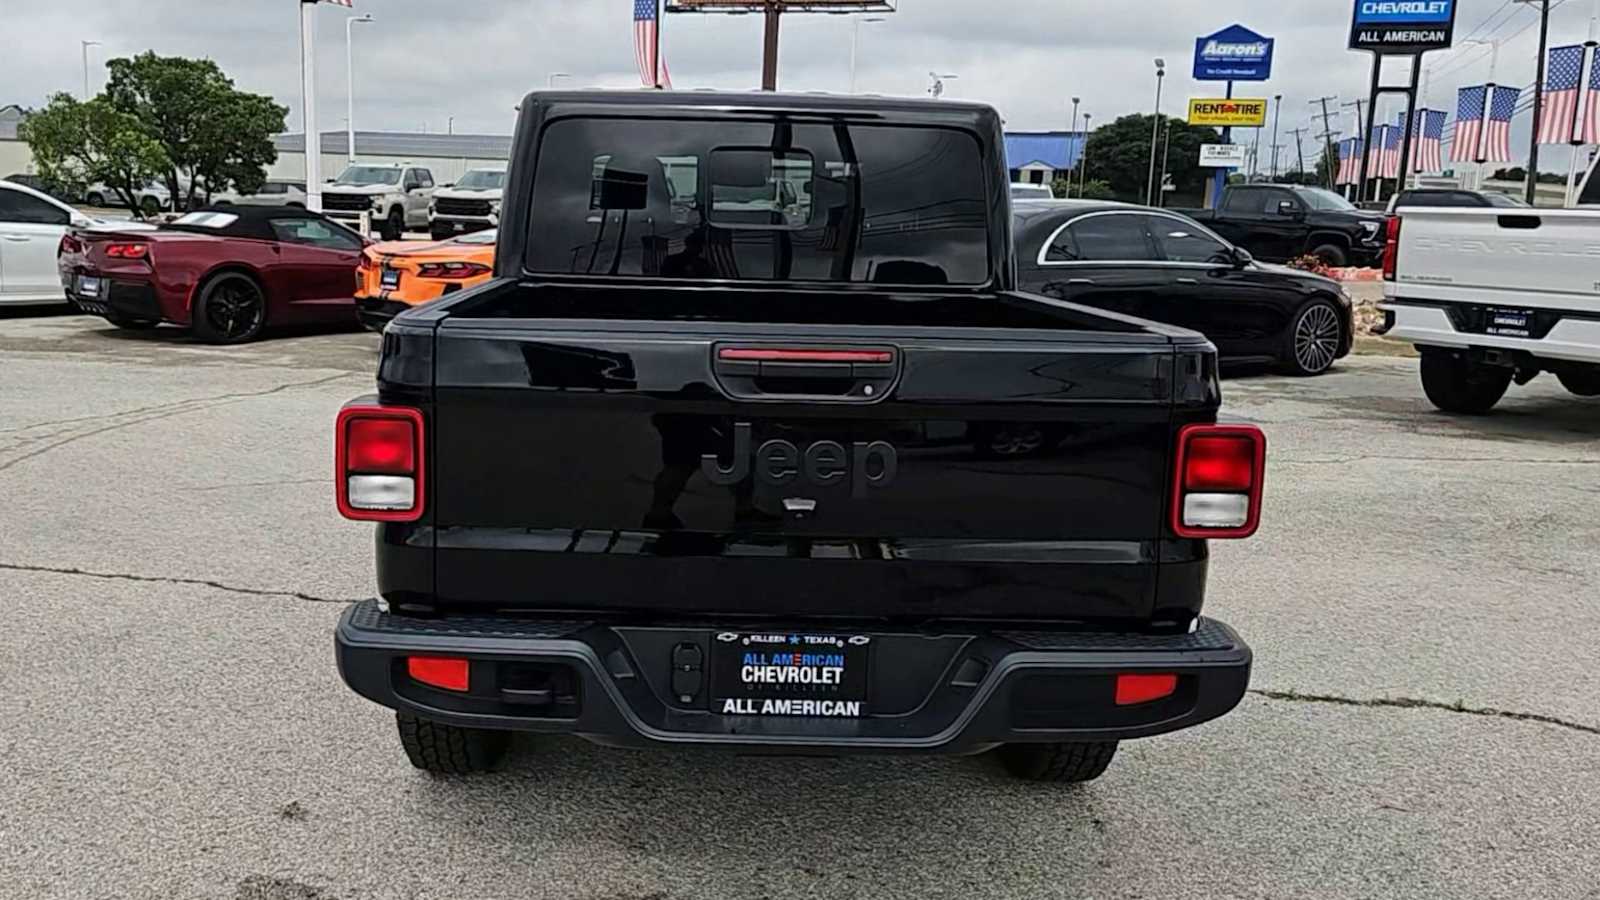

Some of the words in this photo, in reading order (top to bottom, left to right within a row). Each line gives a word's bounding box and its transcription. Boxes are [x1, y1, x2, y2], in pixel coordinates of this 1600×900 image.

[1362, 1, 1448, 14] CHEVROLET
[1359, 31, 1380, 42] ALL
[1383, 31, 1445, 42] AMERICAN
[1201, 40, 1268, 56] Aaron's
[1415, 236, 1600, 258] CHEVROLE
[701, 422, 898, 499] Jeep
[750, 635, 786, 643] KILLEEN
[804, 636, 836, 644] TEXAS
[743, 653, 768, 665] ALL
[772, 653, 844, 666] AMERICAN
[741, 666, 844, 684] CHEVROLET
[722, 699, 757, 714] ALL
[761, 699, 860, 716] AMERICAN
